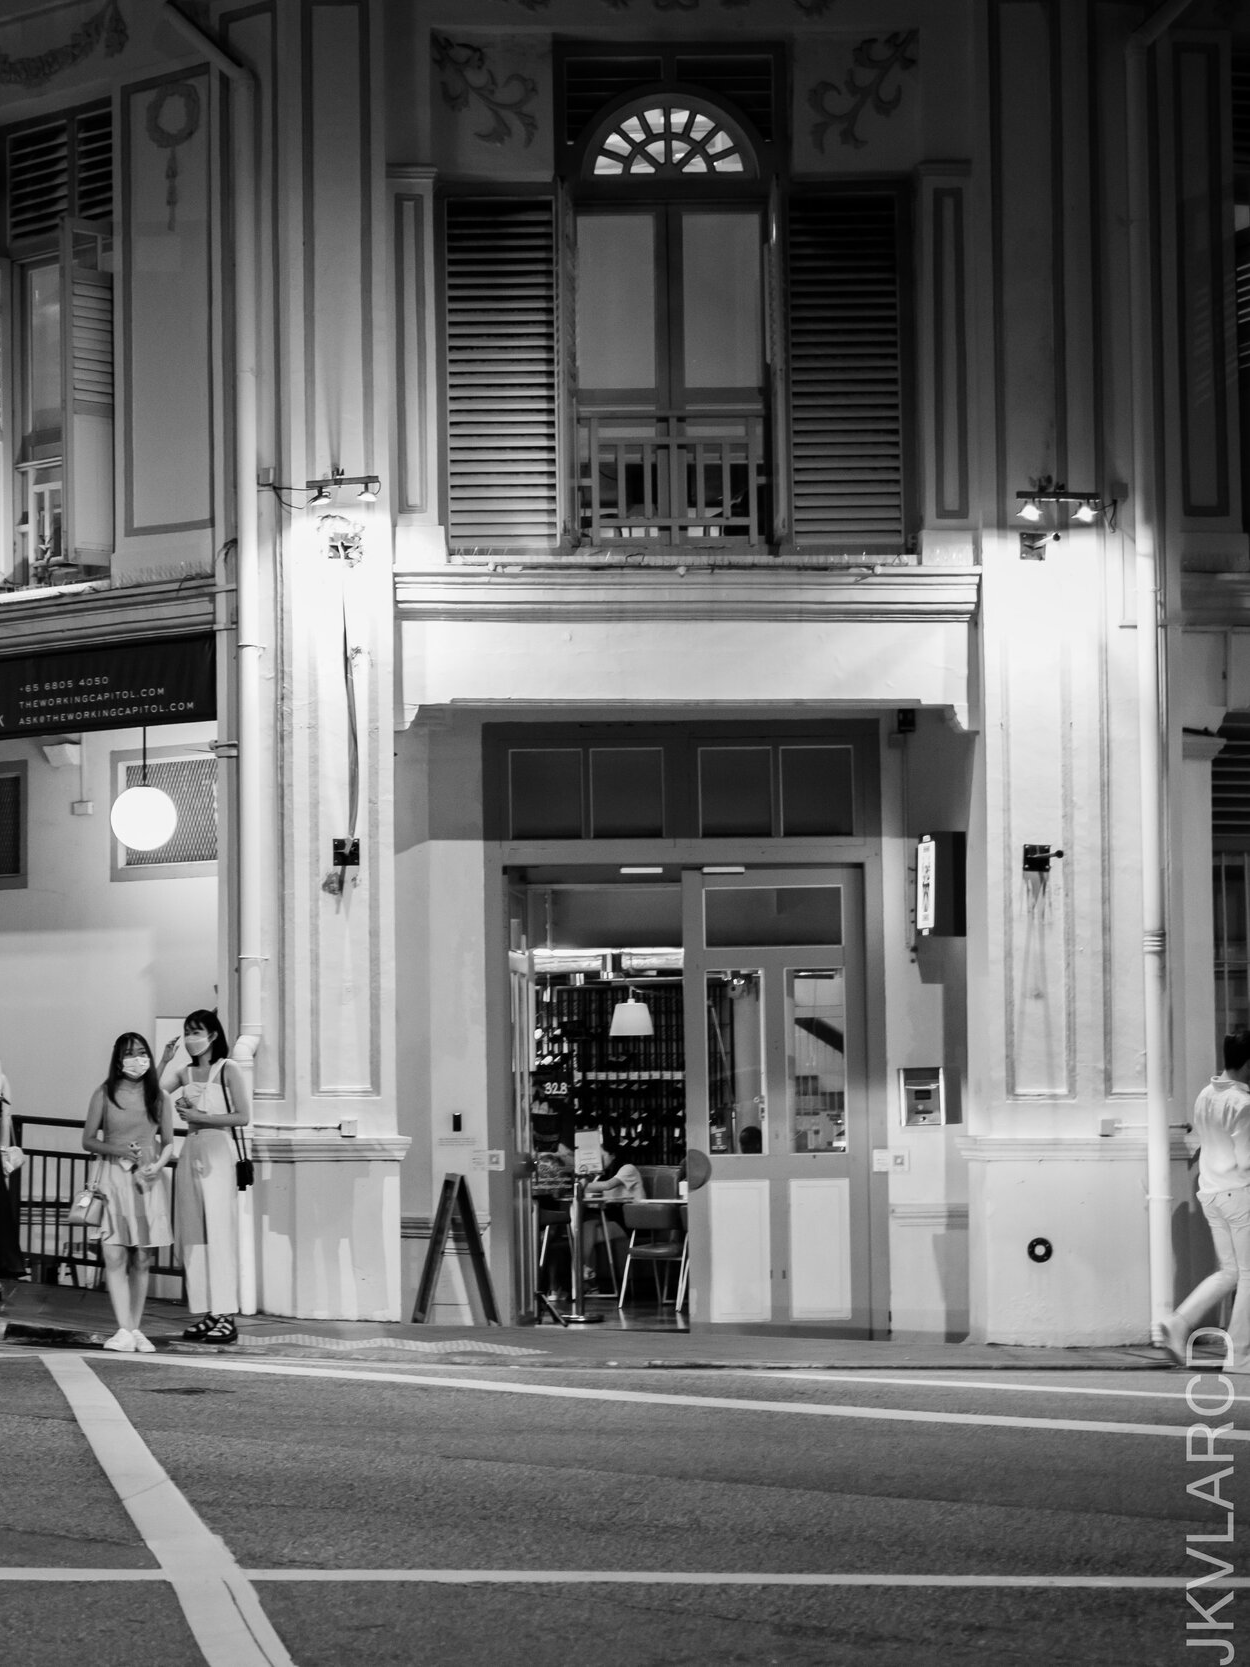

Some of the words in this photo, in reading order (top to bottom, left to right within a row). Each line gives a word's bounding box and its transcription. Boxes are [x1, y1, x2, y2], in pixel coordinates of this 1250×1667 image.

[44, 680, 74, 691] 6805
[78, 676, 109, 686] 4050
[18, 687, 165, 709] THEWORKINGCAPITOL.COM
[18, 701, 195, 726] ASK@THEWORKINGCAPITOL.COM
